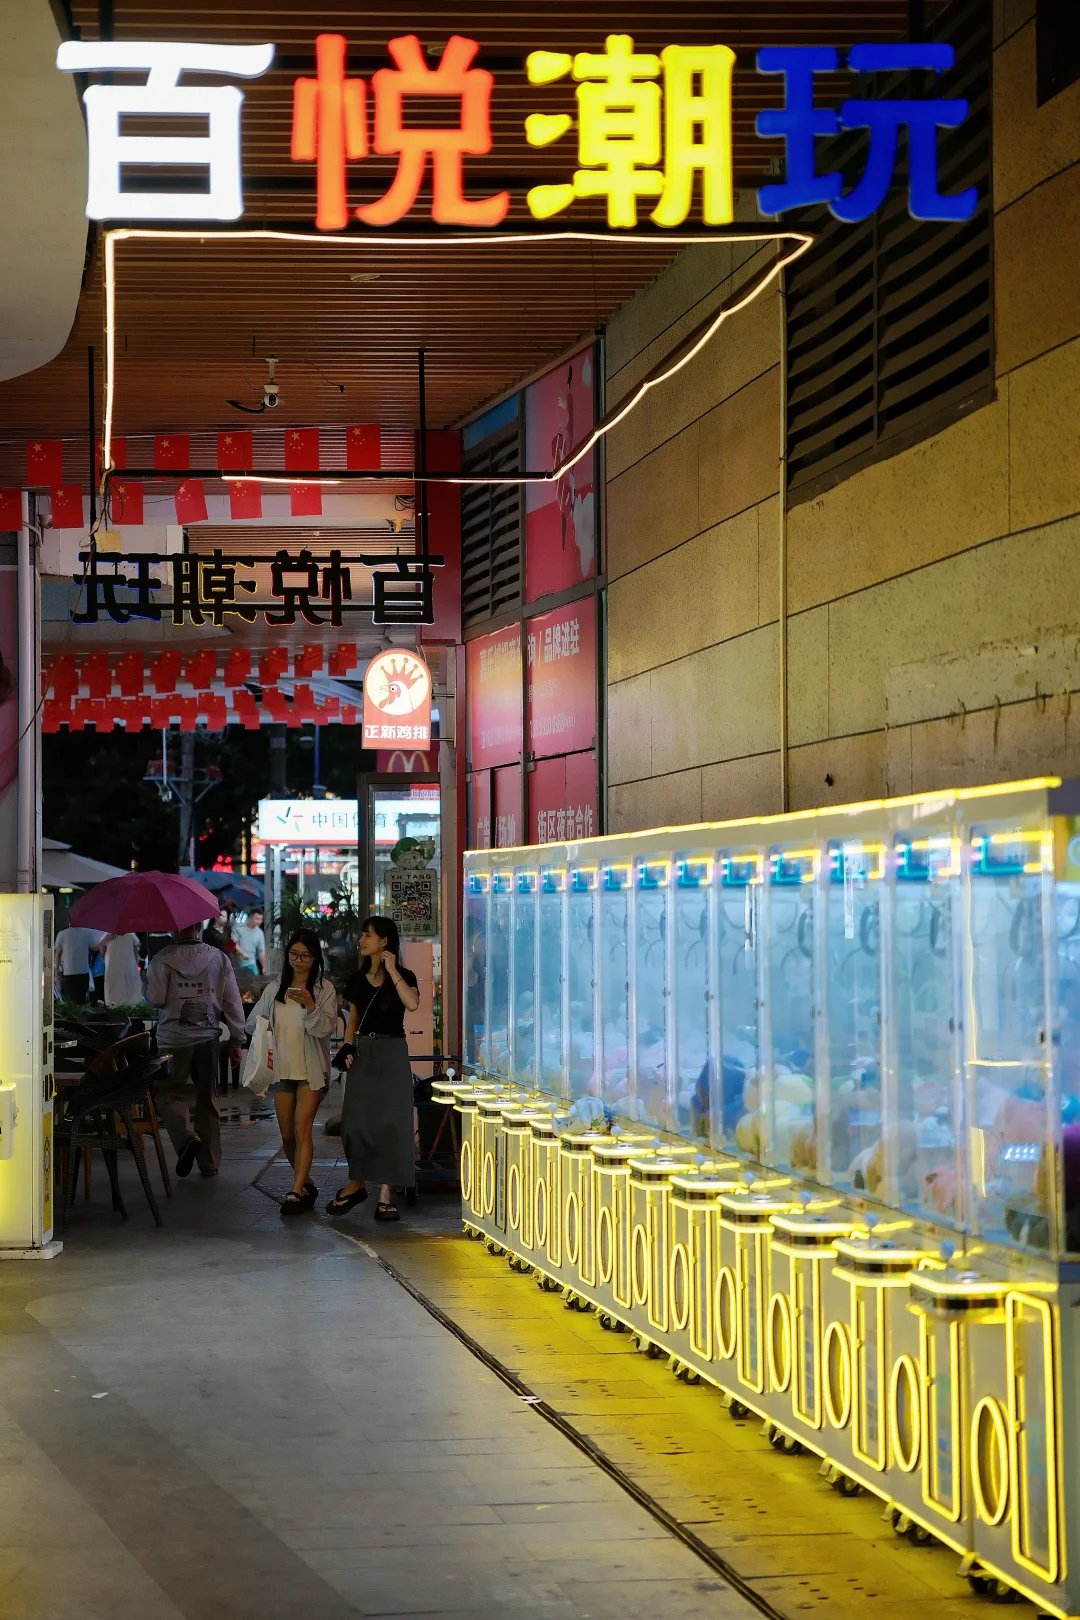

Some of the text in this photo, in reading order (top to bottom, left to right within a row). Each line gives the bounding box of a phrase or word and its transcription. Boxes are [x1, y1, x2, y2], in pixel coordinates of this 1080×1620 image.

[56, 33, 979, 229] 百悦潮玩
[364, 725, 428, 739] 正新鸡排
